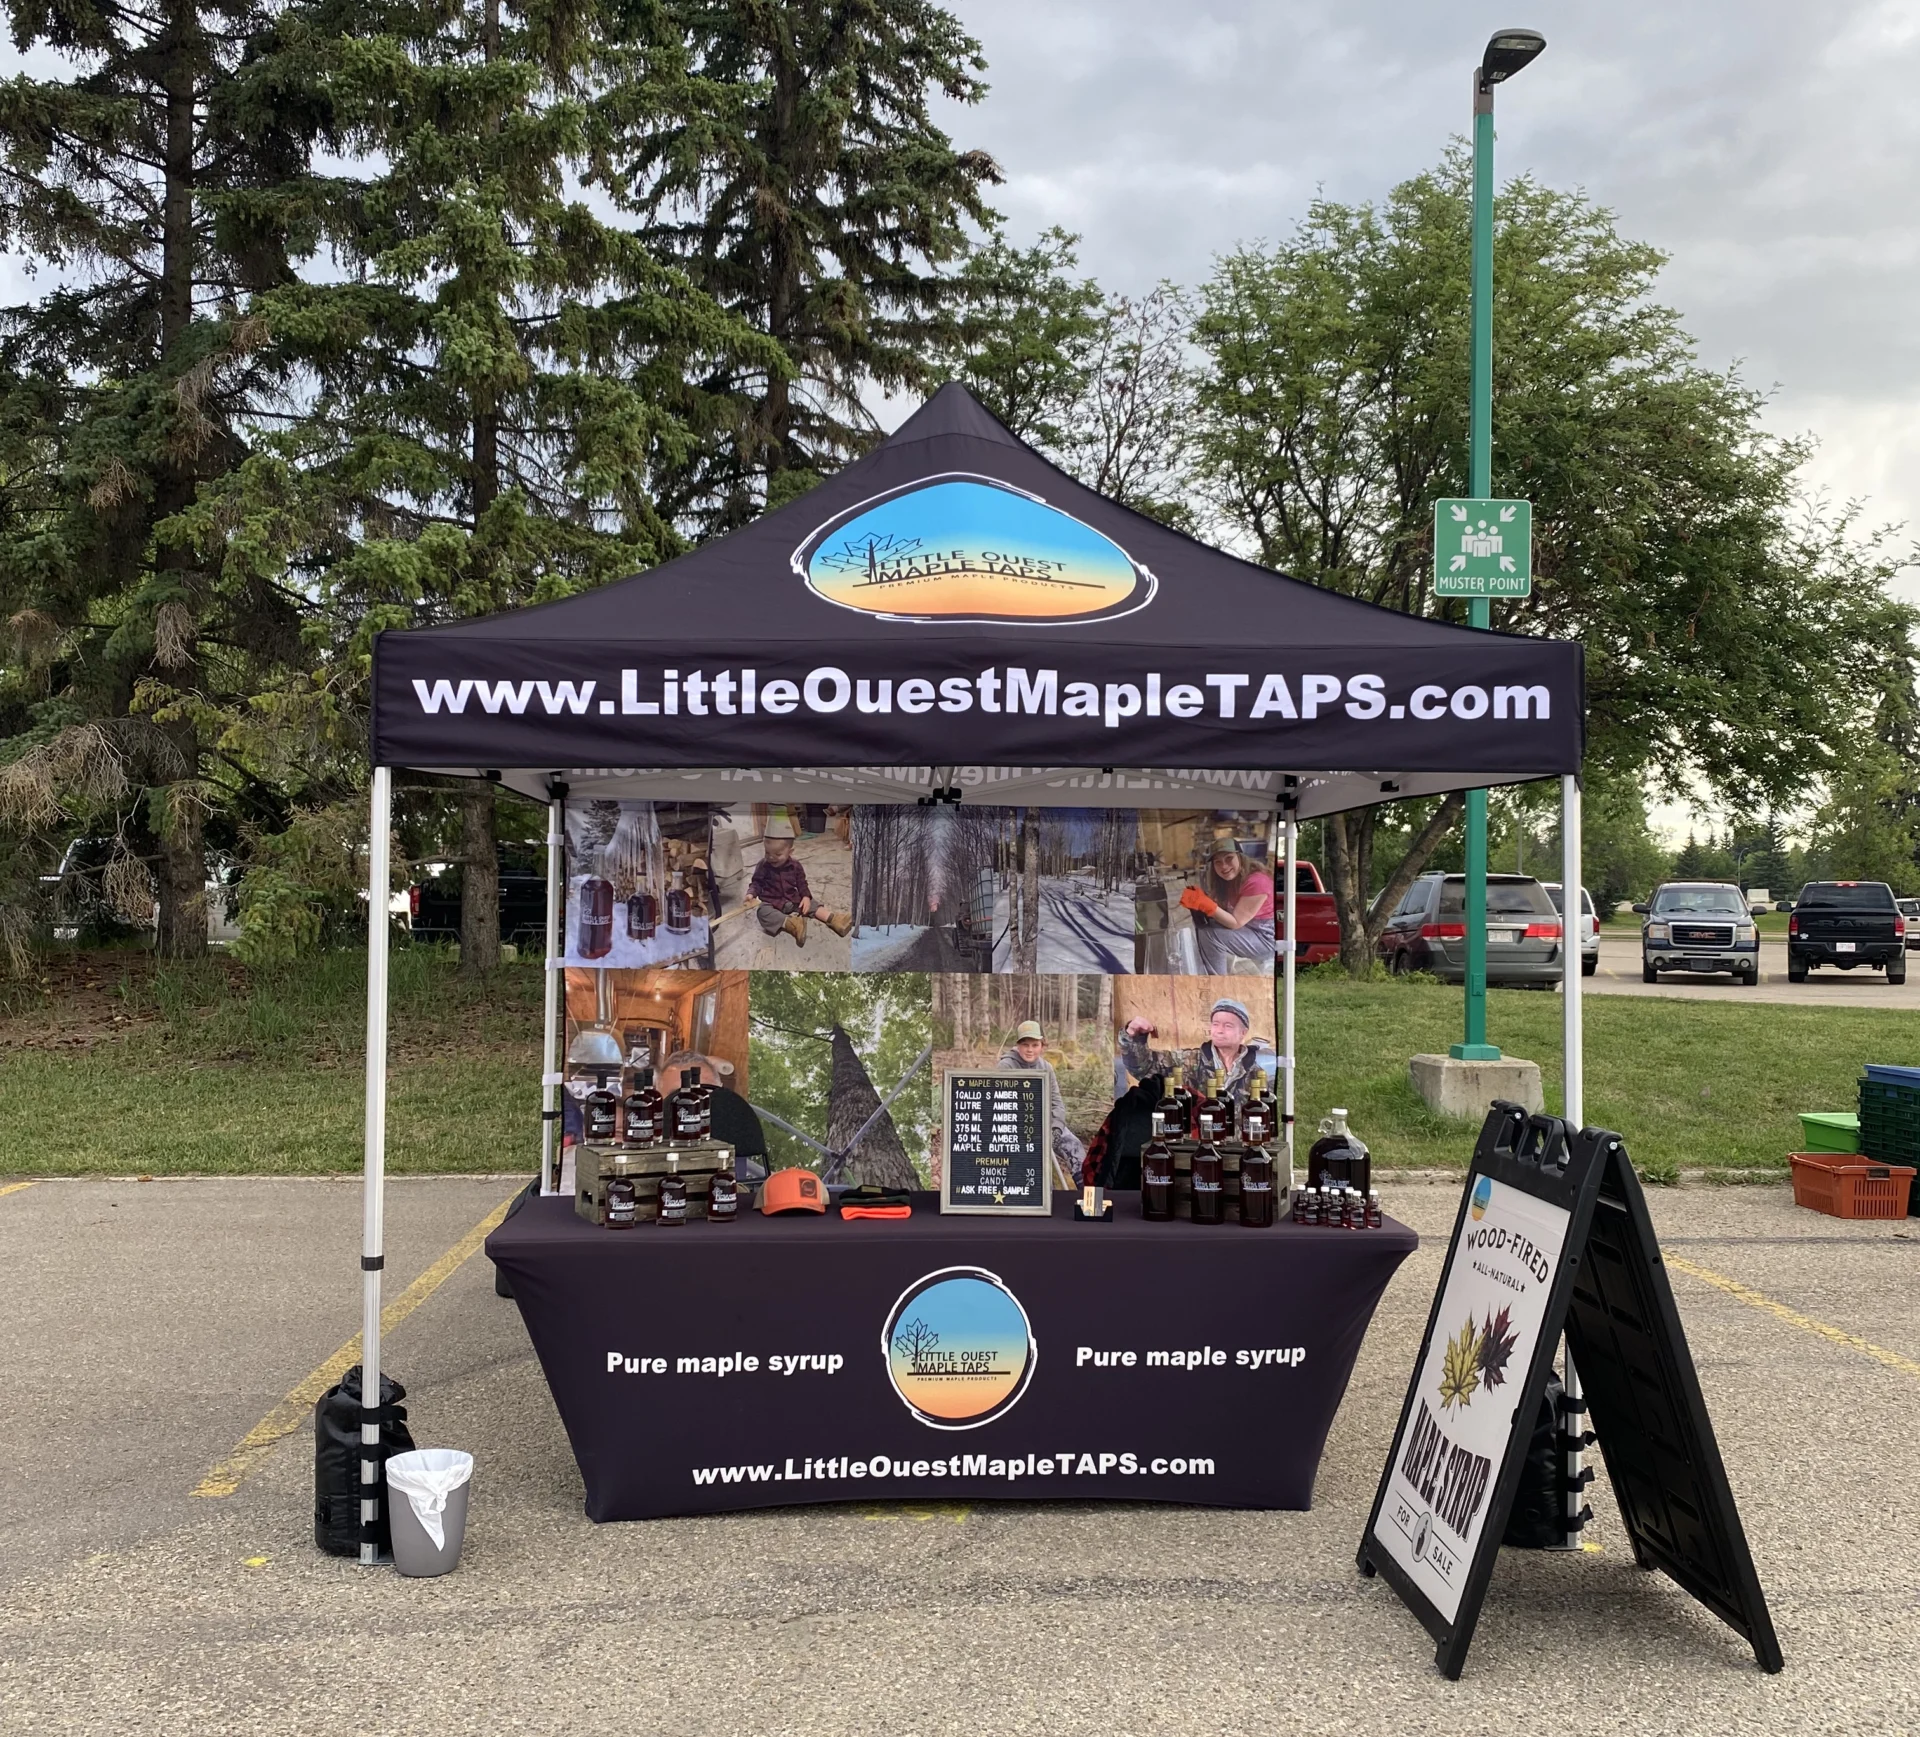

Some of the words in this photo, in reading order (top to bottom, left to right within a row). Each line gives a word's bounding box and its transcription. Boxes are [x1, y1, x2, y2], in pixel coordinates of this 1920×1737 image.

[880, 550, 966, 571] LITTLE
[879, 560, 975, 583] MAPLE
[982, 561, 1053, 581] TAPS
[879, 576, 943, 589] PREMIUM
[1003, 576, 1075, 590] PRODUCTS
[1439, 577, 1485, 590] MUSTER
[1489, 578, 1526, 590] POINT
[1688, 931, 1716, 939] GMC
[968, 1079, 991, 1088] MAPLE
[994, 1080, 1019, 1088] SYRUP
[993, 1091, 1018, 1099] AMBER
[1022, 1092, 1034, 1100] 110
[960, 1101, 982, 1109] LITRE
[993, 1102, 1019, 1111] AMBER
[1024, 1103, 1034, 1111] 35
[955, 1112, 970, 1121] 500
[971, 1113, 982, 1122] ML
[992, 1113, 1018, 1122] AMBER
[1023, 1114, 1034, 1123] 25
[954, 1124, 970, 1133] 375
[970, 1124, 982, 1133] ML
[991, 1124, 1018, 1133] AMBER
[1023, 1126, 1034, 1134] 20
[957, 1134, 968, 1142] 50
[970, 1134, 982, 1143] ML
[992, 1134, 1019, 1143] AMBER
[1026, 1135, 1031, 1143] 5
[952, 1143, 982, 1152] MAPLE
[988, 1143, 1020, 1152] BUTTER
[1025, 1143, 1035, 1152] 15
[975, 1157, 1010, 1166] PREMIUM
[980, 1167, 1007, 1176] SMOKE
[1025, 1168, 1035, 1177] 30
[979, 1176, 1007, 1185] CANDY
[1025, 1178, 1035, 1186] 25
[978, 1186, 998, 1194] FREE
[1002, 1186, 1030, 1195] SAMPLE
[1467, 1228, 1549, 1284] WOOD-FIRED
[1476, 1262, 1520, 1292] ALL-NATURAL
[919, 1352, 955, 1361] LITTLE
[1076, 1347, 1137, 1366] Pure
[1146, 1346, 1227, 1370] maple
[1235, 1347, 1306, 1369] syrup
[607, 1352, 667, 1373] Pure
[676, 1351, 759, 1377] maple
[768, 1354, 844, 1376] syrup
[918, 1362, 958, 1373] MAPLE
[960, 1362, 990, 1373] TAPS
[1401, 1396, 1450, 1508] MAPLE
[1434, 1443, 1493, 1543] SYRUP
[1396, 1505, 1411, 1528] FOR
[1432, 1546, 1454, 1576] SALE
